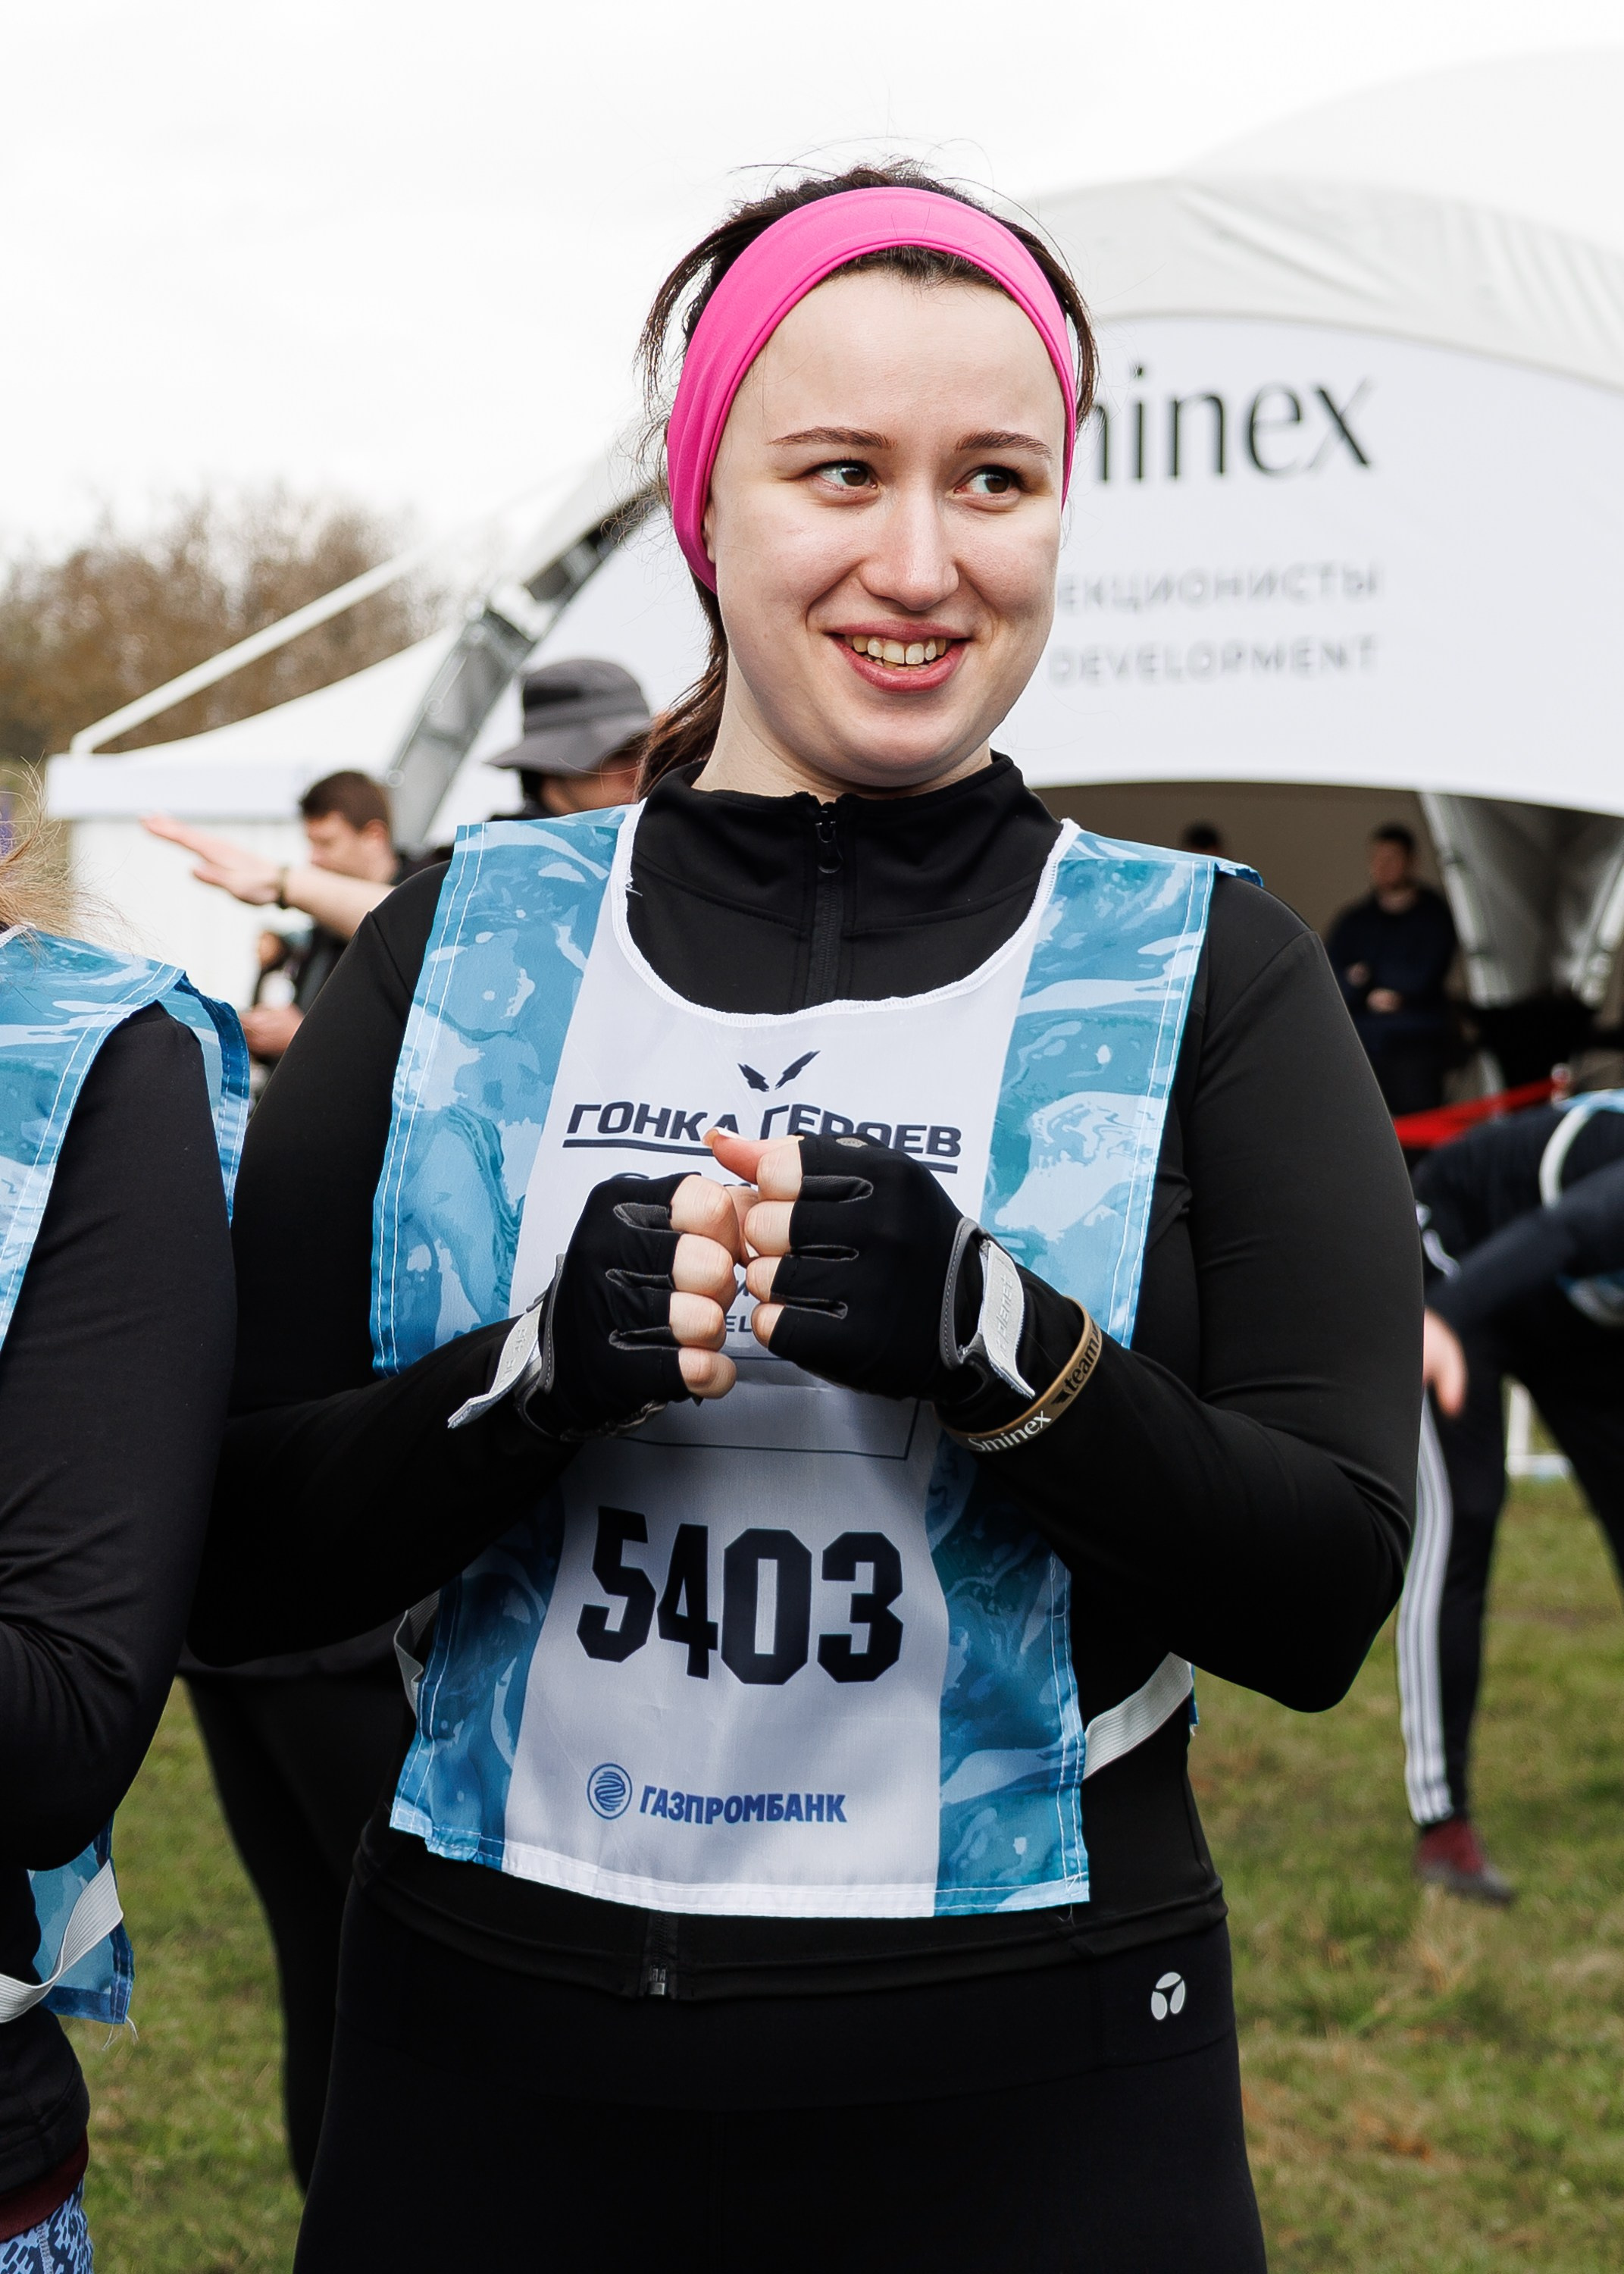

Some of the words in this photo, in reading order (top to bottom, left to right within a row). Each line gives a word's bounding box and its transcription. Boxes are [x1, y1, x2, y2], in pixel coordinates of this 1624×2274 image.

[1056, 562, 1381, 611] ЕКЦИОНИСТЫ
[1049, 635, 1378, 682] DEVELOPMENT
[968, 1410, 1052, 1452] Sminex
[576, 1505, 904, 1685] 5403
[639, 1785, 847, 1825] ГАЗПРОМБАНК
